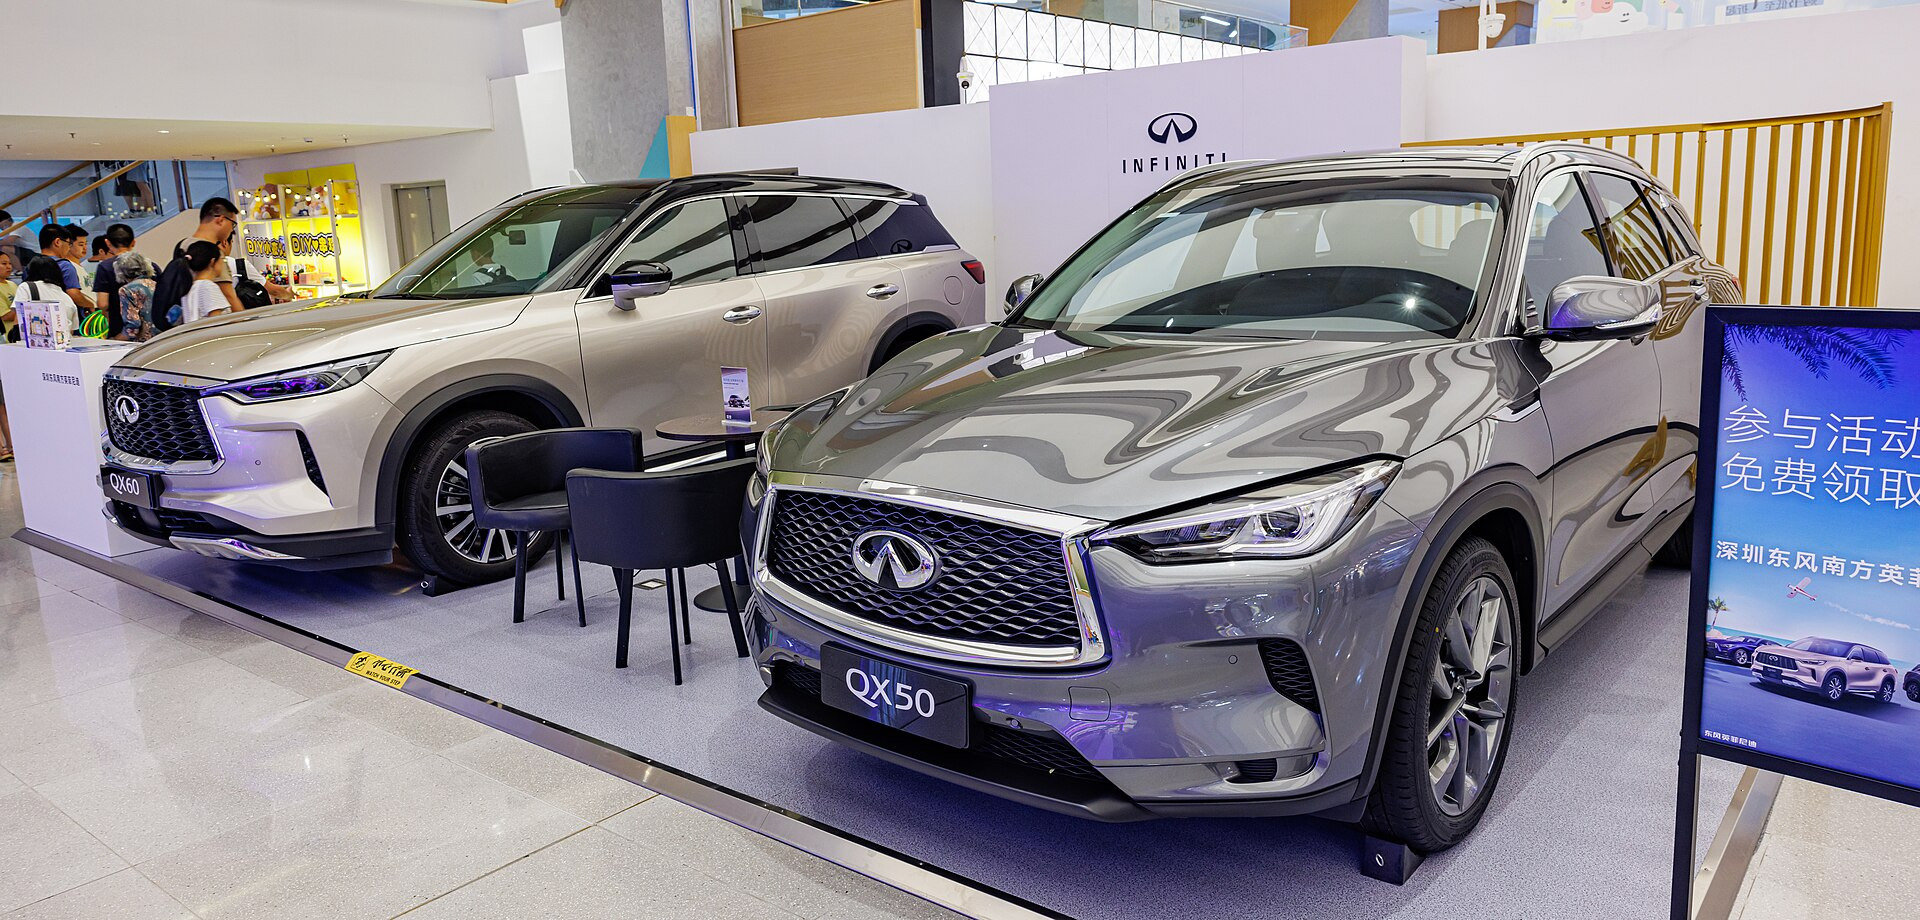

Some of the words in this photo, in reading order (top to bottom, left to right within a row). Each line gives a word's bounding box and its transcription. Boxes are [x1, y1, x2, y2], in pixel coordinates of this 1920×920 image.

[1122, 152, 1226, 174] INFINITI
[1723, 404, 1920, 460] 参与活动
[109, 472, 140, 496] QX60
[1720, 451, 1920, 510] 免费领取
[365, 670, 379, 678] WATCH
[379, 674, 391, 682] YOUR
[389, 678, 401, 686] STEP
[845, 667, 936, 718] QX50
